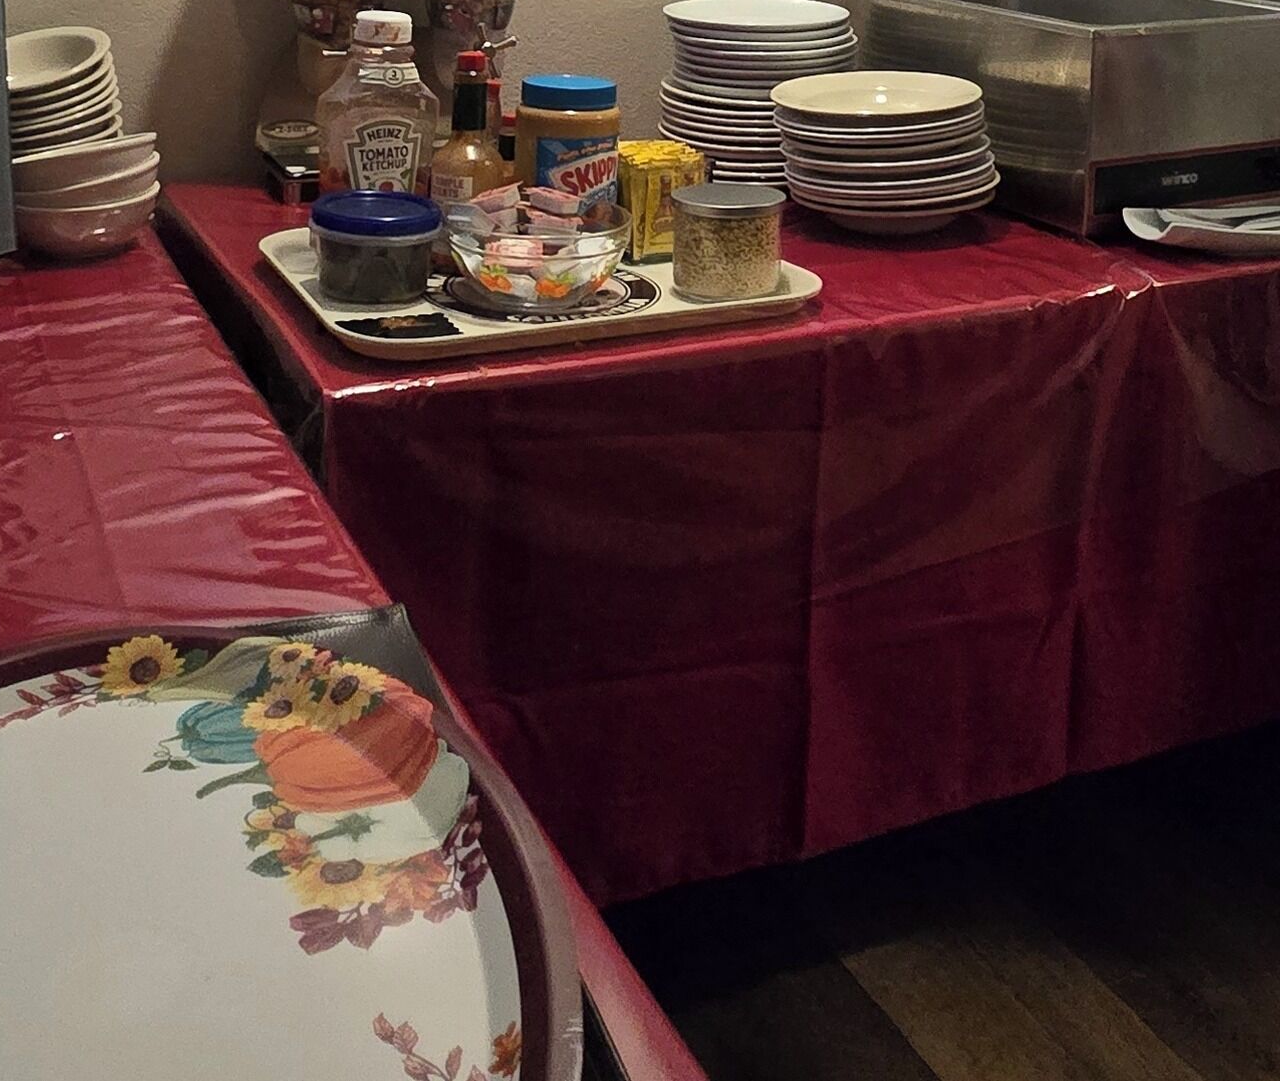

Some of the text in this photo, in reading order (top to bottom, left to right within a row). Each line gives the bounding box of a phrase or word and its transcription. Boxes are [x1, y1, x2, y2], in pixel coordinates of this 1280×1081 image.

[366, 128, 402, 141] HEINZ
[359, 145, 409, 161] TOMATO
[361, 159, 407, 172] KETCHUP
